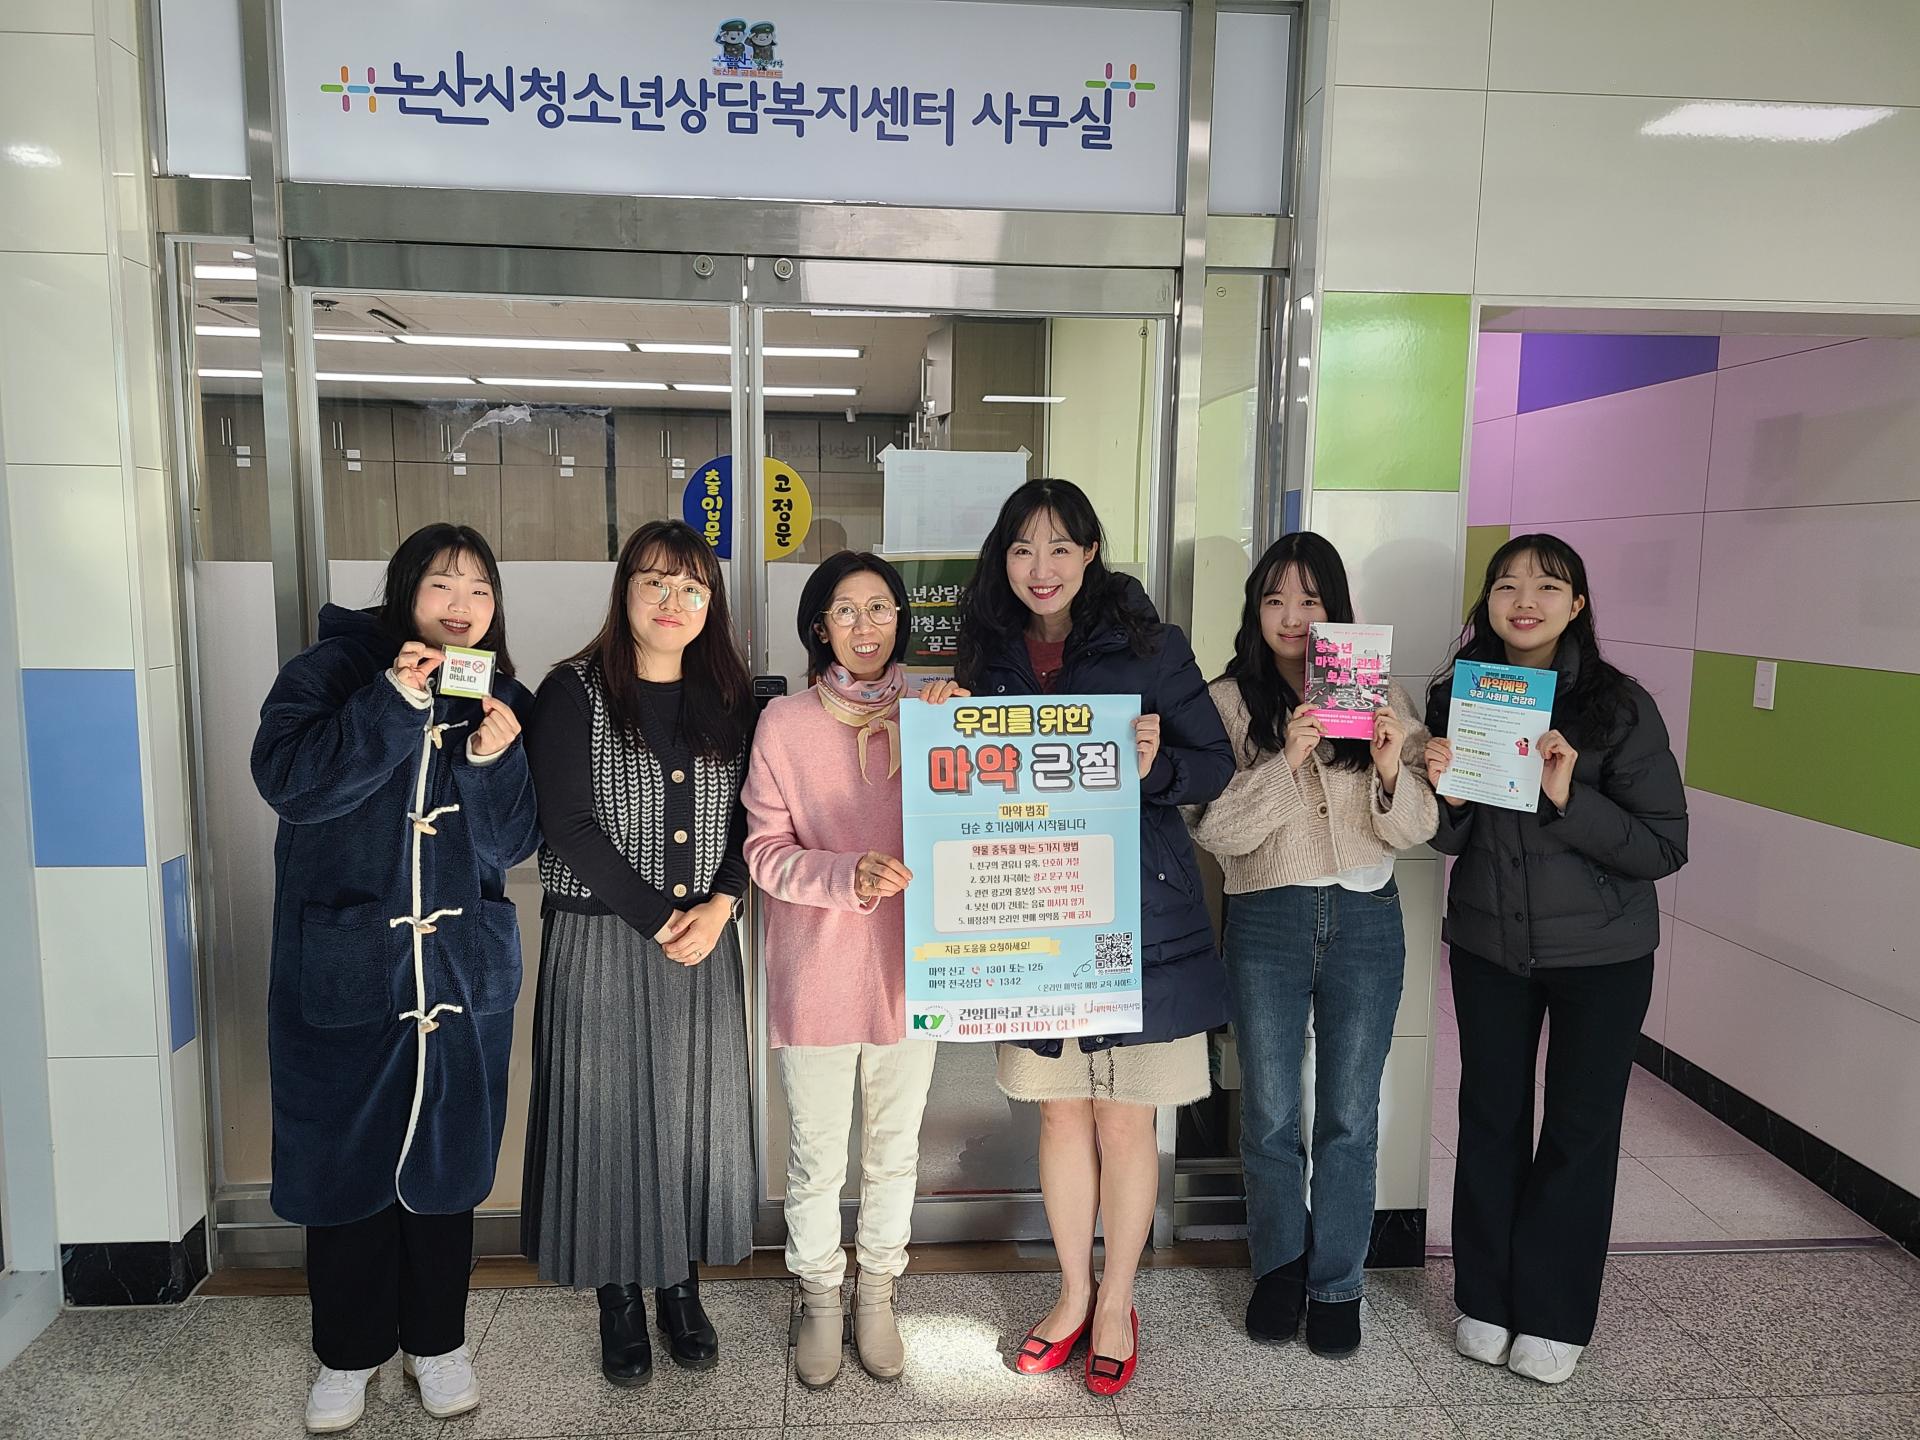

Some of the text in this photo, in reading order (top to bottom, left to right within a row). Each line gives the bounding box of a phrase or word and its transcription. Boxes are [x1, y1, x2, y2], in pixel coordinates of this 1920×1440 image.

[374, 50, 1113, 150] 논산시청소년상담복지센터 사무실
[702, 469, 723, 547] 출입문
[772, 474, 793, 547] 고정문
[451, 658, 472, 668] 마약은
[1480, 677, 1528, 694] 마약예방
[1469, 690, 1484, 699] 우리
[955, 704, 1093, 736] 우리를 위한
[929, 741, 1120, 794] 마약 근절
[961, 819, 1086, 834] 단순 호기심에서 시작됩니다
[972, 842, 1079, 855] 약물 중독을 막는 5가지 방법
[977, 861, 998, 870] 친구의
[980, 875, 1000, 884] 호기심
[1015, 887, 1035, 896] 홍보성
[1070, 884, 1084, 893] 차단
[975, 903, 988, 911] 낯선
[1032, 900, 1045, 908] 음료
[999, 914, 1019, 923] 온라인
[1038, 912, 1059, 921] 의약품
[1062, 911, 1076, 919] 구매
[945, 941, 1030, 954] 지금 도움을 요청하세요!
[929, 962, 1044, 976] 마약 신고 1301 또는 125
[929, 977, 1021, 988] 마약 전국상담 1342
[959, 1006, 1022, 1020] 건양대학교
[913, 1015, 945, 1029] KY
[1011, 1020, 1051, 1033] STUDY
